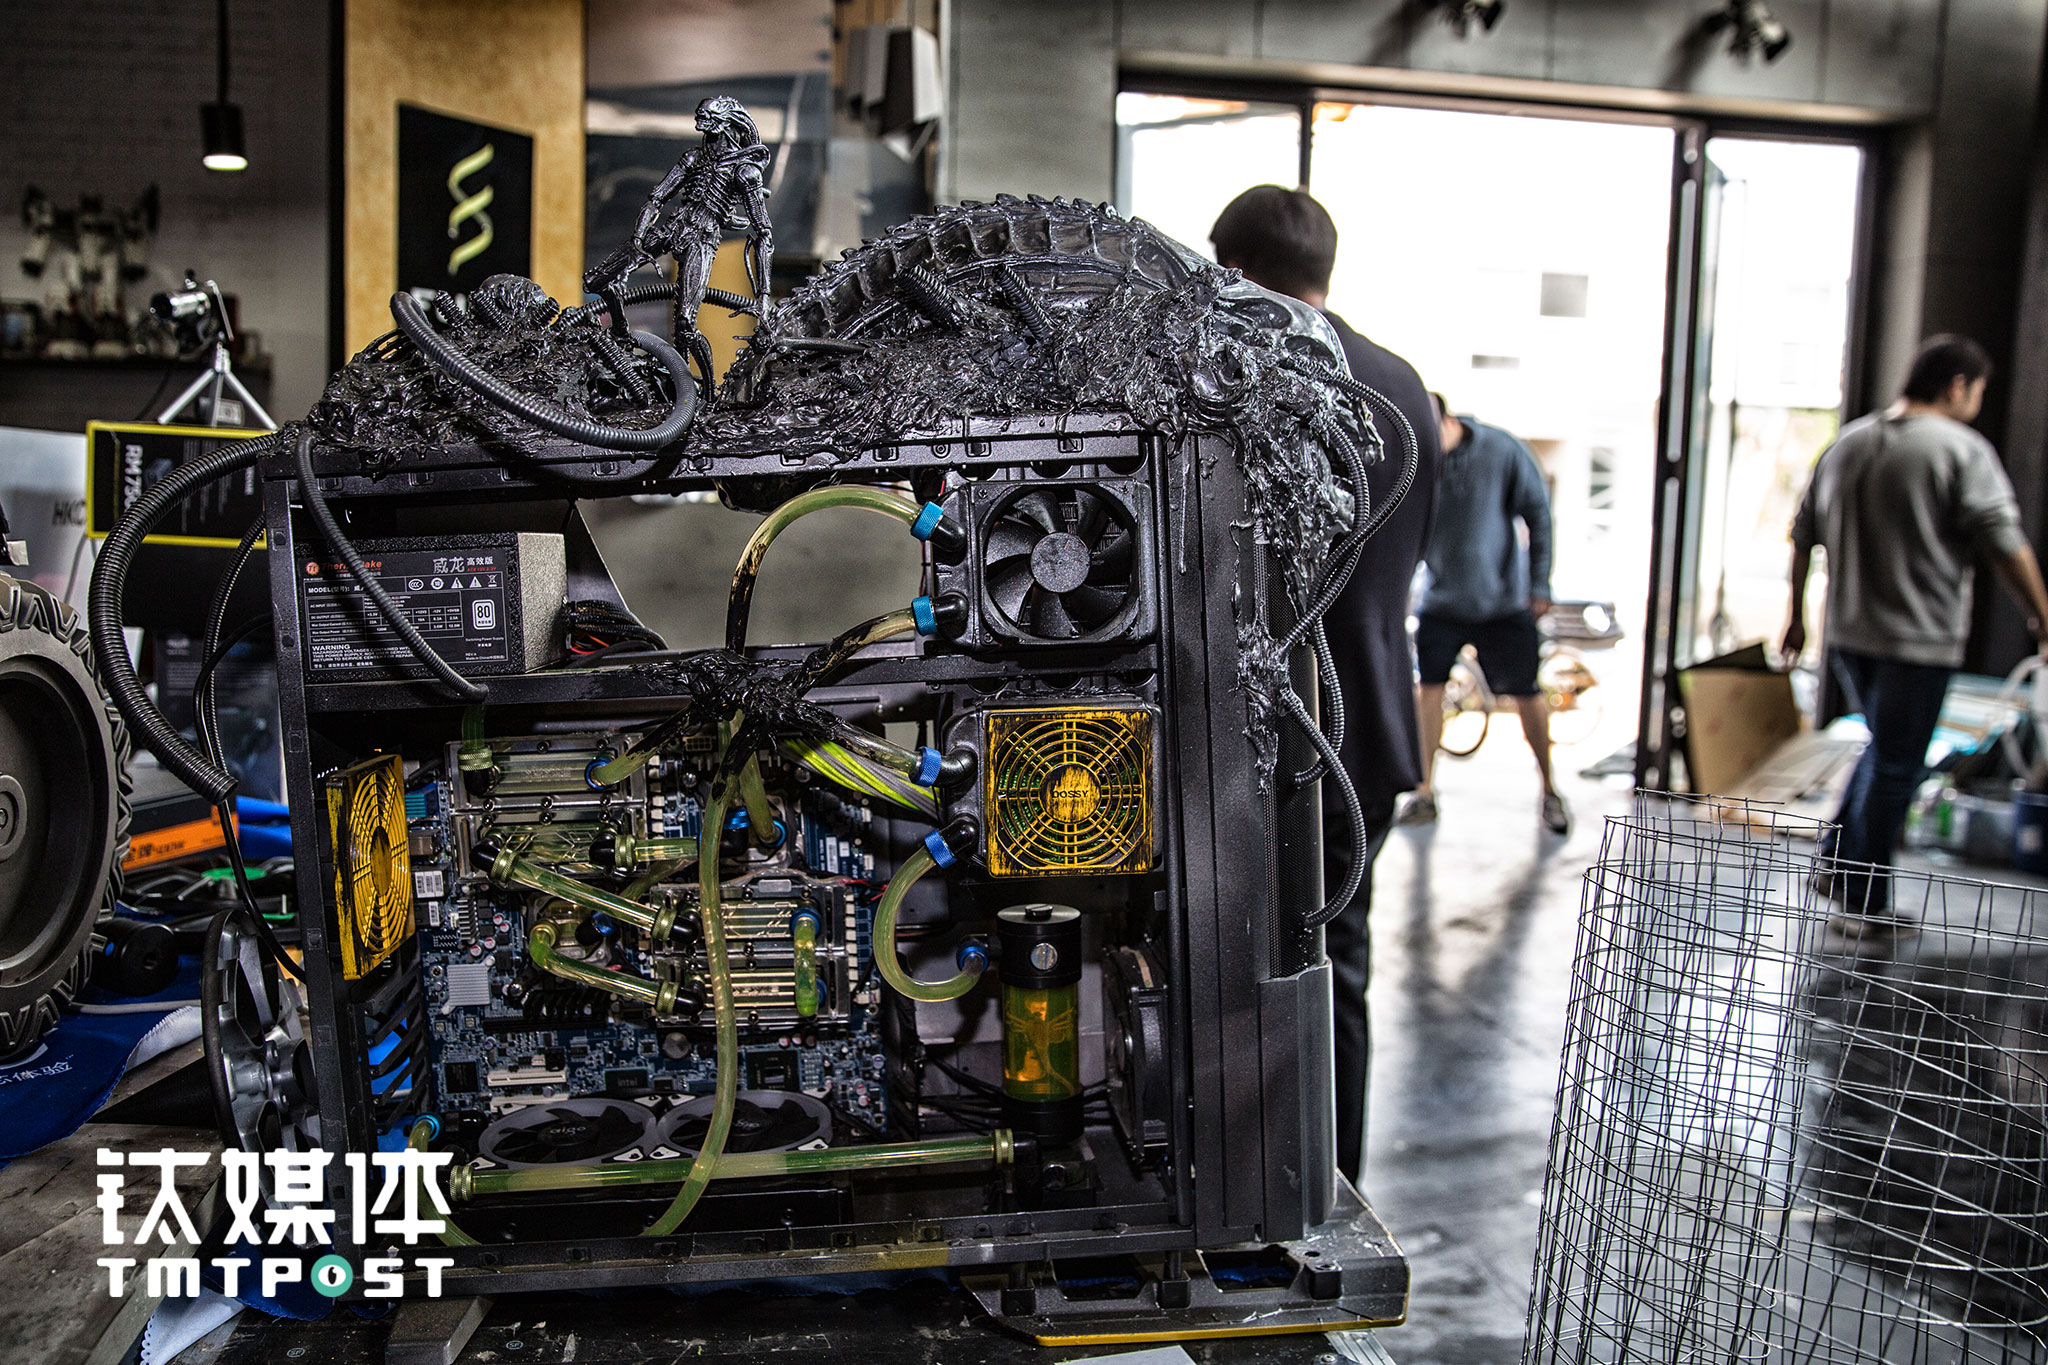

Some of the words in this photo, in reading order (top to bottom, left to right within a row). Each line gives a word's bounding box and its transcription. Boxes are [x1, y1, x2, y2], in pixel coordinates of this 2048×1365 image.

[433, 556, 465, 574] 威龙
[477, 605, 491, 619] 80
[550, 1125, 586, 1136] aigo
